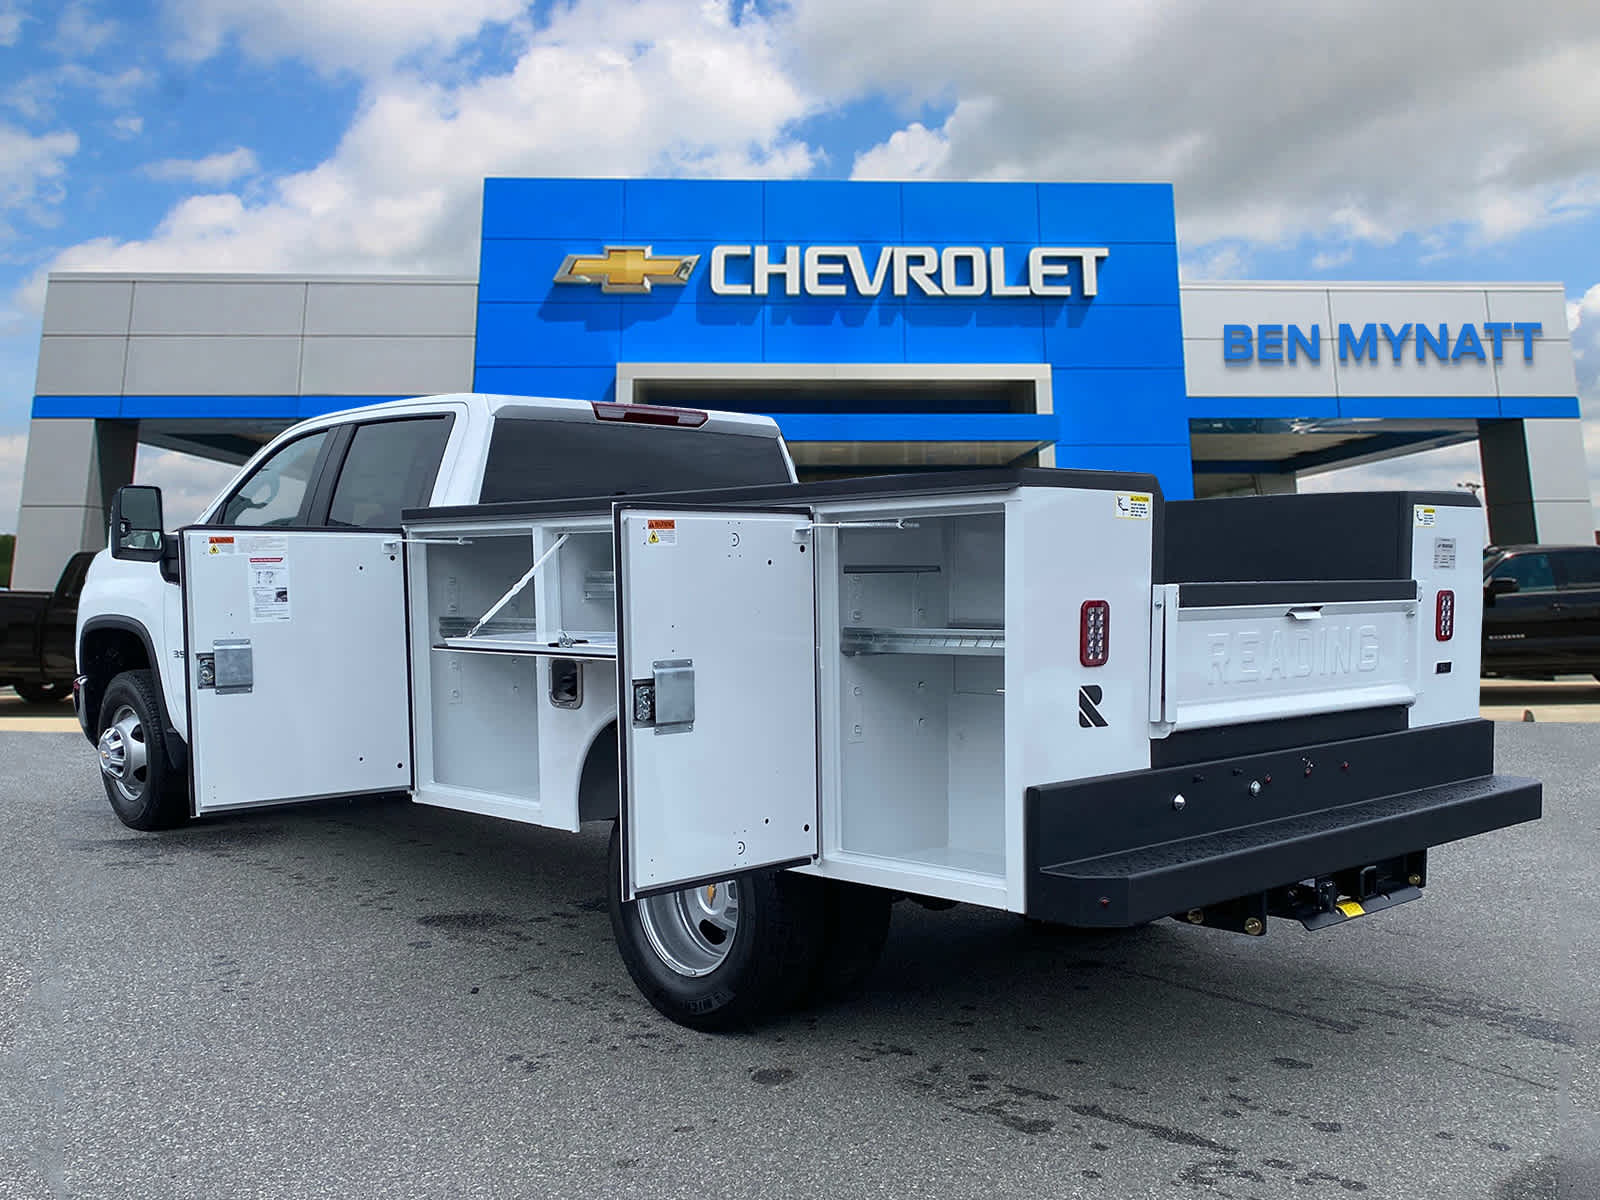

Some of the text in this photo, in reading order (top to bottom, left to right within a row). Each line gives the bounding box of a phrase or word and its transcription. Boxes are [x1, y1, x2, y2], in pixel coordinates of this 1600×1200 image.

[710, 245, 1109, 297] CHEVROLET
[1223, 322, 1543, 364] BEN MYNATT
[1207, 625, 1380, 687] READING
